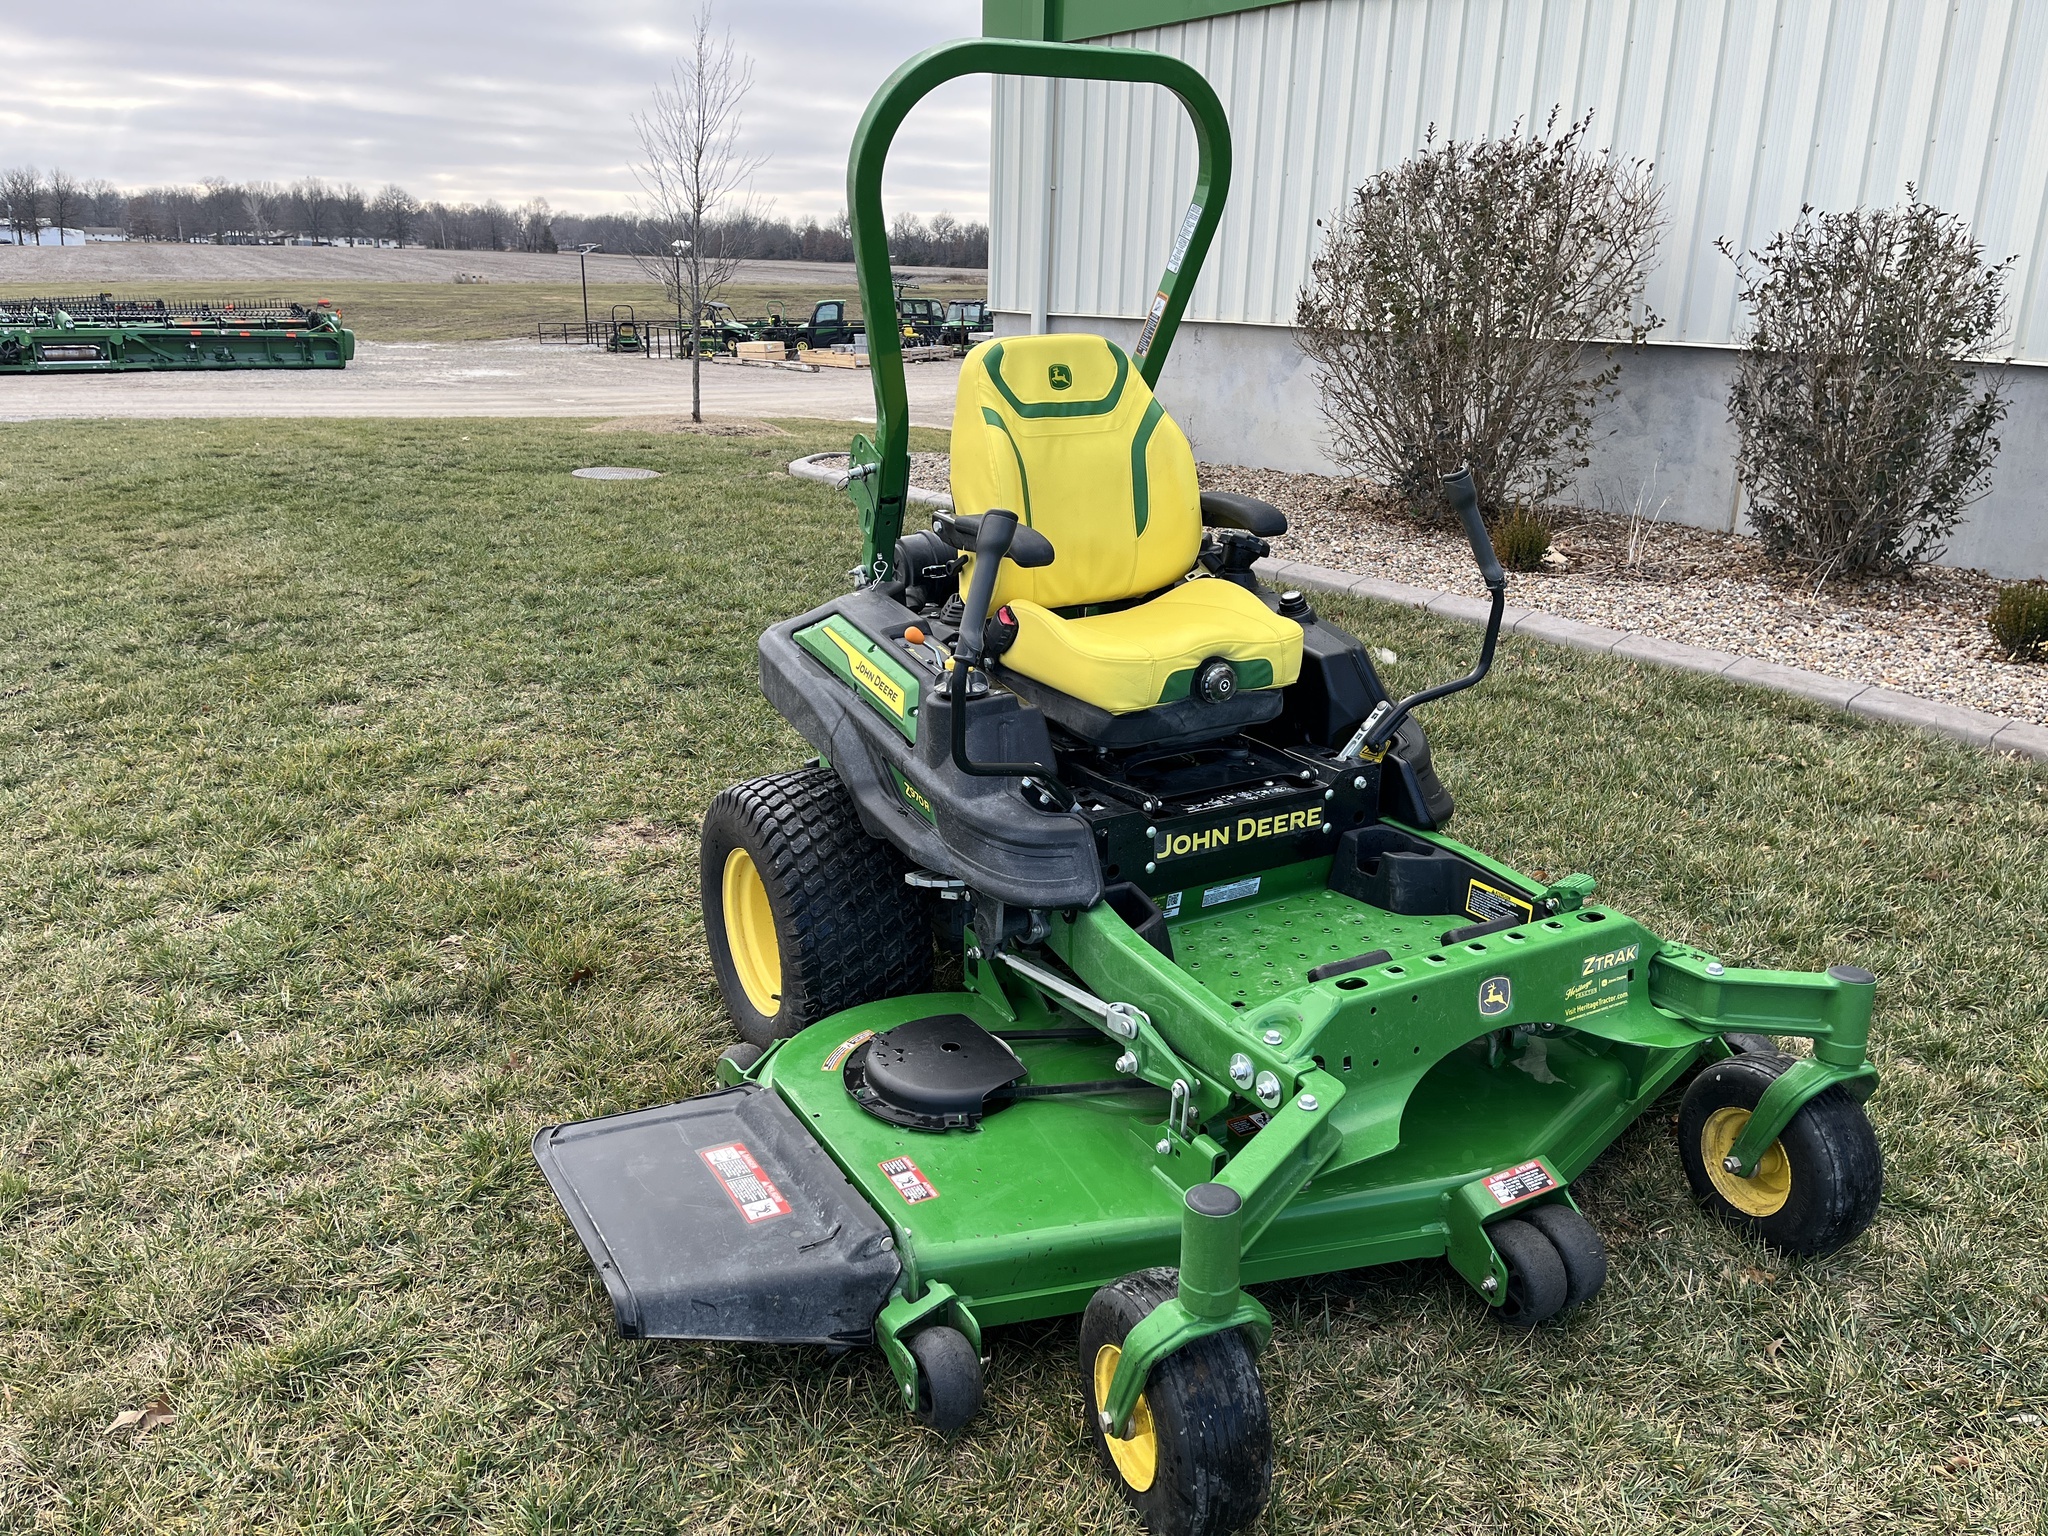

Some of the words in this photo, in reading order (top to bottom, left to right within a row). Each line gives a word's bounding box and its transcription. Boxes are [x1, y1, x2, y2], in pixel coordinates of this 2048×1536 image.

[855, 660, 875, 682] JOHN
[873, 675, 899, 703] DEERE
[903, 781, 931, 813] Z970R
[1156, 826, 1230, 859] JOHN
[1237, 806, 1322, 842] DEERE
[1582, 945, 1637, 976] ZTRAK
[1564, 979, 1593, 1001] Heritage
[1564, 1006, 1577, 1017] Visit
[1576, 992, 1629, 1013] HeritageTractor.com
